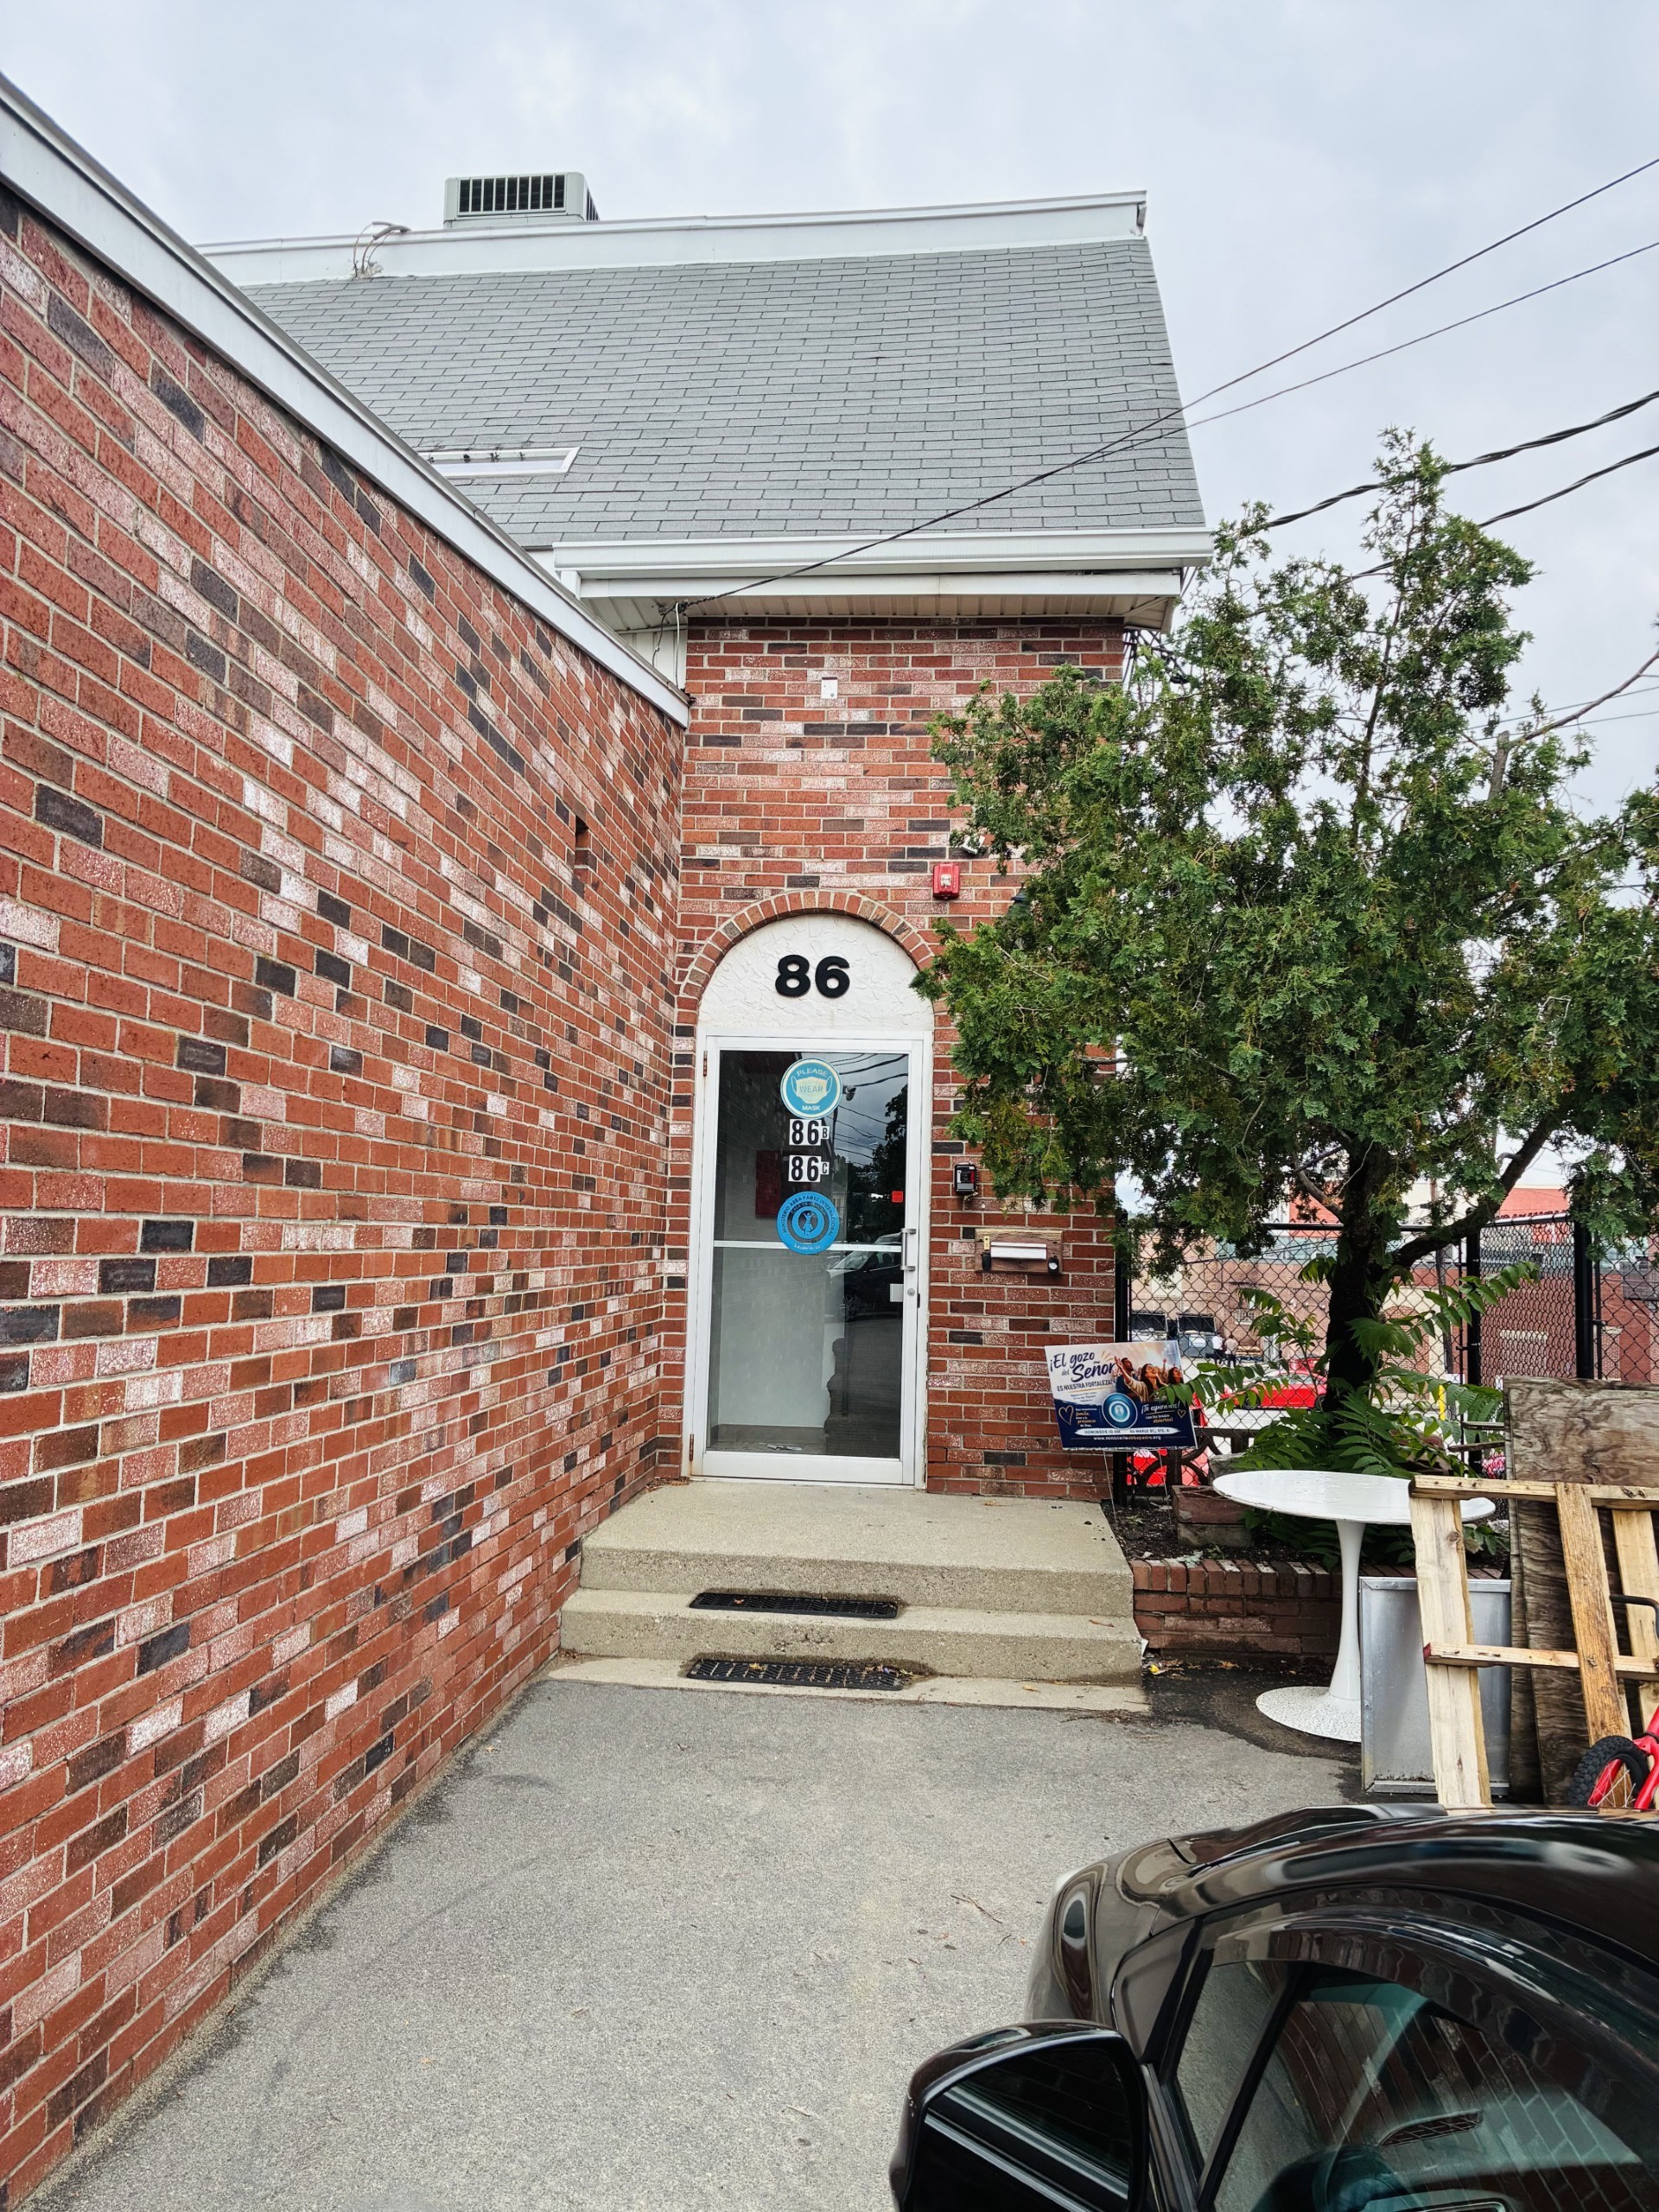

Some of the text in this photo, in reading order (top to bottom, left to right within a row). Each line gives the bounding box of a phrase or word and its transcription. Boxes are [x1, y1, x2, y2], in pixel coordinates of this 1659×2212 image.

[775, 954, 850, 999] 86
[797, 1068, 828, 1077] PLEASE
[1050, 1352, 1095, 1372] ¡El gozo
[1071, 1361, 1116, 1382] Señor
[1064, 1382, 1085, 1391] NUESTRA
